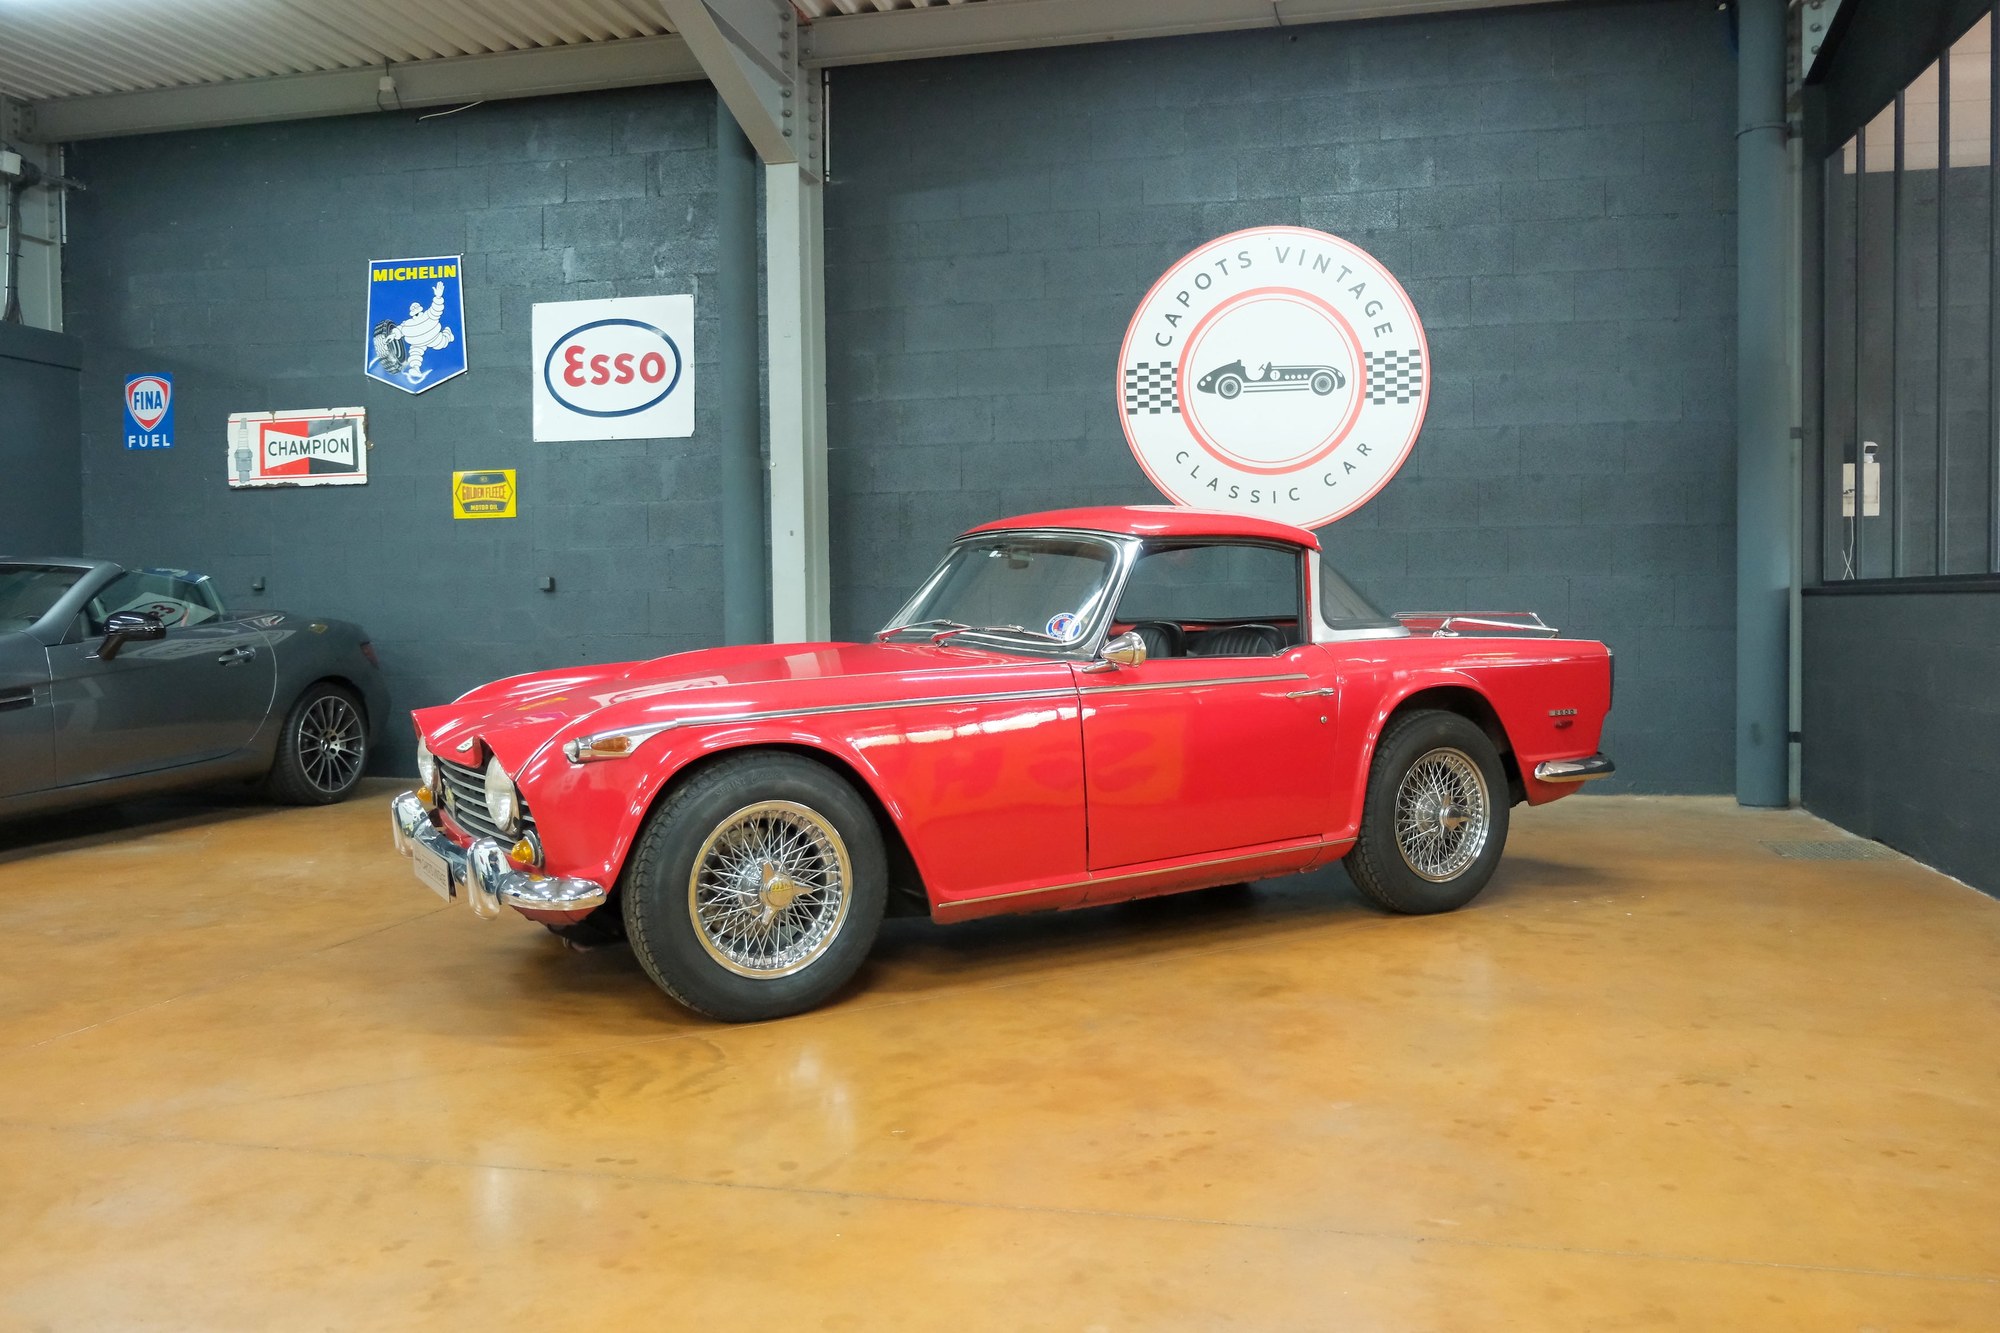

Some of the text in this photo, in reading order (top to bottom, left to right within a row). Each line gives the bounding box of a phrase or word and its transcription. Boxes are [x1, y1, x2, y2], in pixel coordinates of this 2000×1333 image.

[373, 265, 457, 282] MICHELIN
[1155, 246, 1393, 347] CAPOTS VINTAGE
[133, 390, 163, 410] FINA
[128, 433, 171, 448] FUEL
[268, 438, 350, 457] CHAMPION
[1175, 442, 1372, 504] CLASSIC CAR
